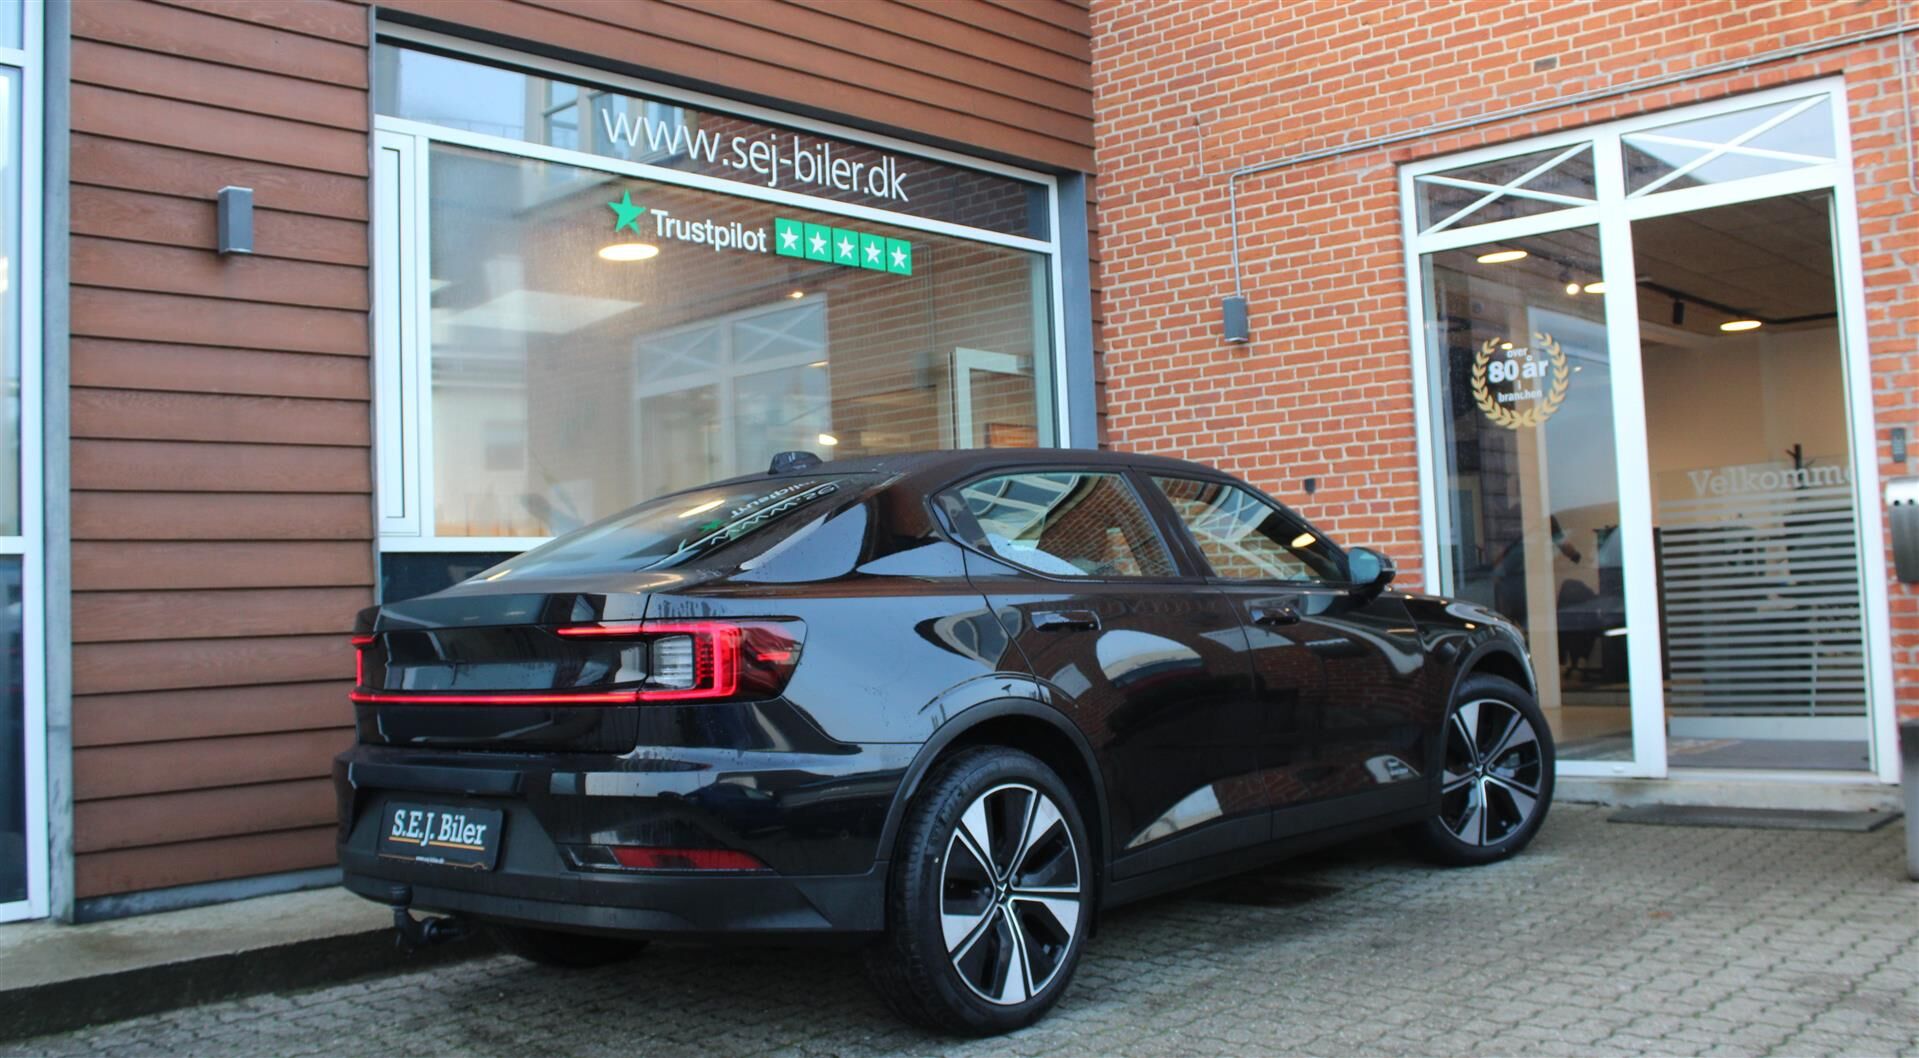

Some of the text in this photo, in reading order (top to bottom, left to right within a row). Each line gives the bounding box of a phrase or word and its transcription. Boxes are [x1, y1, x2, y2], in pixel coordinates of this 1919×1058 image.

[602, 108, 909, 202] www.sej-biler.dk
[651, 209, 767, 252] Trustpilot
[1488, 355, 1549, 383] 80 år
[1507, 348, 1528, 358] over
[1497, 390, 1542, 402] branchen
[391, 809, 487, 846] S.E.J. Biler
